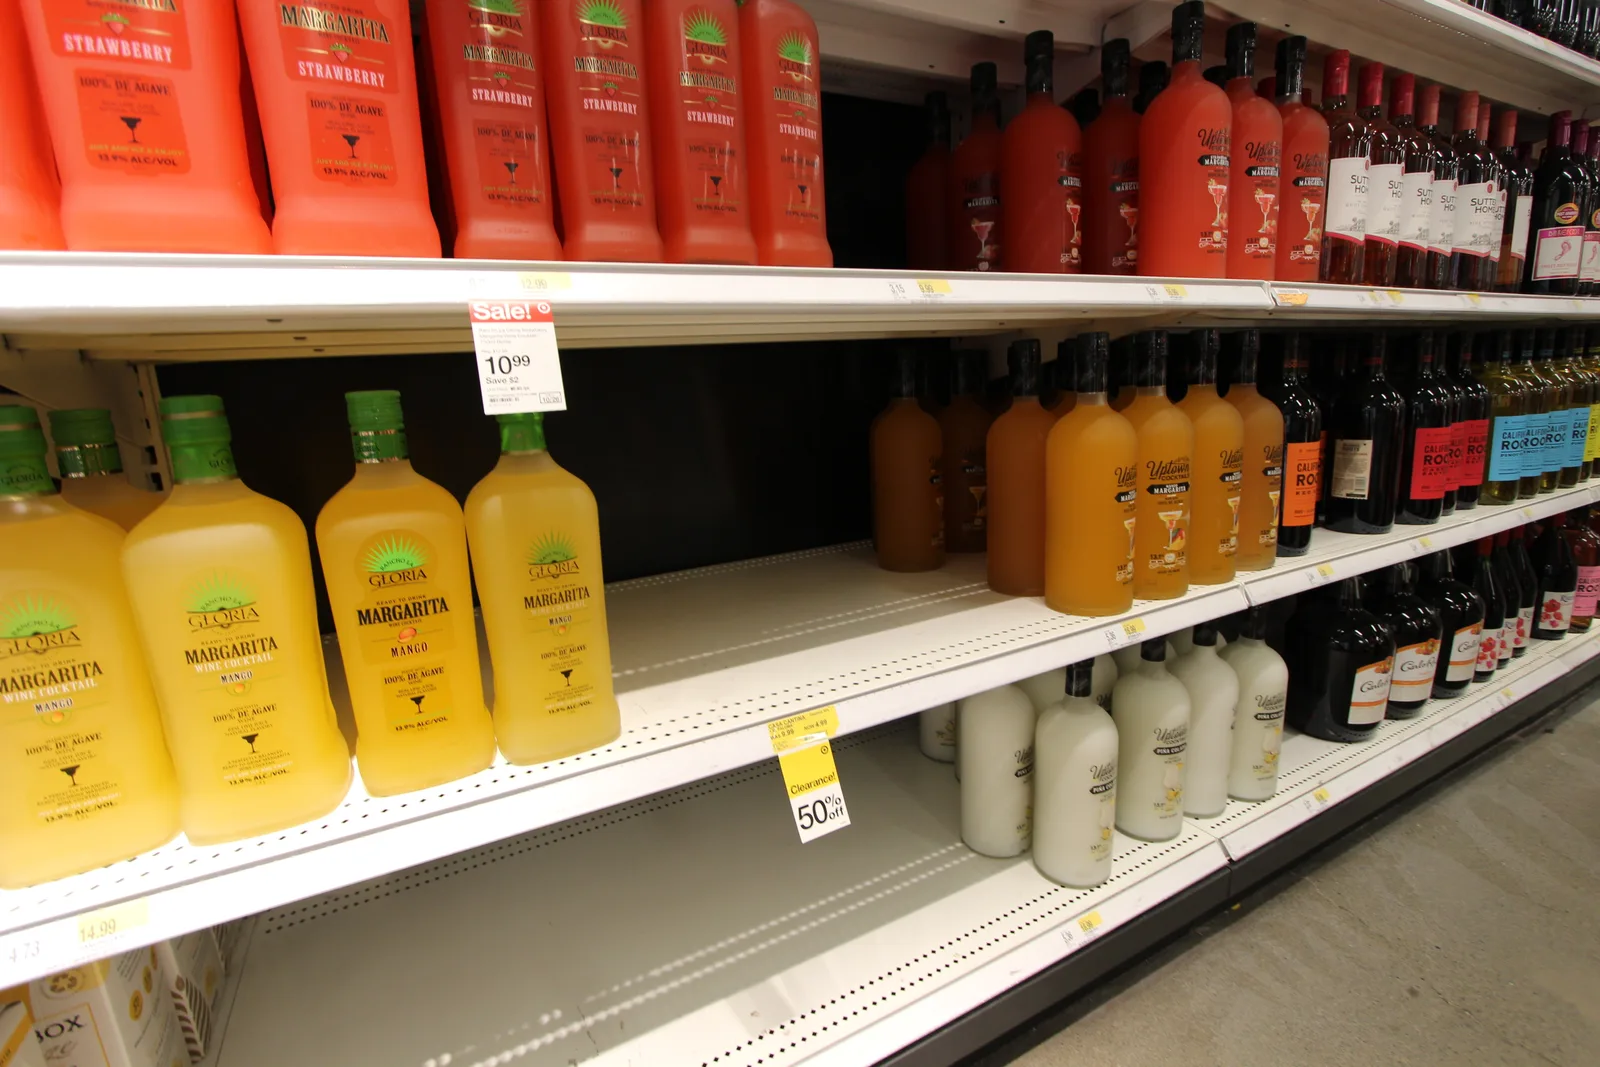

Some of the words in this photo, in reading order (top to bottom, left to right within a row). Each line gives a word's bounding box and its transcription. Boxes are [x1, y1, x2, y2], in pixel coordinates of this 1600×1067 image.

[280, 4, 391, 44] MARGARITA
[580, 24, 628, 41] GLORIA
[63, 32, 173, 64] STRAWBERRY
[685, 40, 727, 58] GLORIA
[462, 44, 535, 71] MARGARITA
[298, 60, 385, 88] STRAWBERRY
[115, 79, 130, 91] DE
[472, 88, 533, 108] STRAWBERRY
[583, 98, 637, 115] STRAWBERRY
[310, 99, 336, 110] 100%
[339, 102, 351, 112] DE
[355, 105, 384, 117] AGAVE
[687, 110, 735, 127] STRAWBERRY
[779, 123, 817, 140] STRAWBERRY
[350, 169, 389, 180] ALC/VOL
[473, 302, 532, 321] Sale!
[486, 377, 507, 385] Save
[1146, 459, 1190, 482] Uptown
[1154, 486, 1187, 496] MARGARITA
[380, 558, 406, 571] RANCHO
[529, 561, 580, 578] GLORIA
[369, 569, 428, 588] GLORIA
[524, 586, 591, 609] MARGARITA
[188, 607, 260, 629] GLORIA
[356, 596, 450, 626] MARGARITA
[549, 615, 572, 626] MANGO
[185, 636, 279, 665] MARGARITA
[391, 642, 429, 658] MANGO
[559, 648, 567, 656] DE
[569, 643, 588, 653] AGAVE
[194, 662, 223, 674] WINE
[224, 653, 273, 670] COCKTAIL
[0, 660, 104, 693] MARGARITA
[220, 670, 253, 684] MANGO
[384, 675, 406, 685] 100%
[407, 672, 418, 681] DE
[421, 666, 445, 677] AGAVE
[3, 689, 37, 703] WINE
[39, 678, 98, 697] COCKTAIL
[34, 698, 74, 714] MANGO
[213, 714, 236, 723] 100%
[237, 710, 249, 718] DE
[252, 703, 278, 716] AGAVE
[768, 722, 783, 730] CASA
[783, 715, 806, 727] CANTINA
[815, 719, 828, 728] 4.99
[781, 728, 795, 738] 9.99
[25, 744, 53, 757] 100%
[55, 739, 69, 750] DE
[72, 731, 103, 746] AGAVE
[790, 771, 837, 795] Clearance!
[798, 793, 842, 830] 50%
[829, 806, 844, 820] off
[80, 918, 117, 942] 14.99
